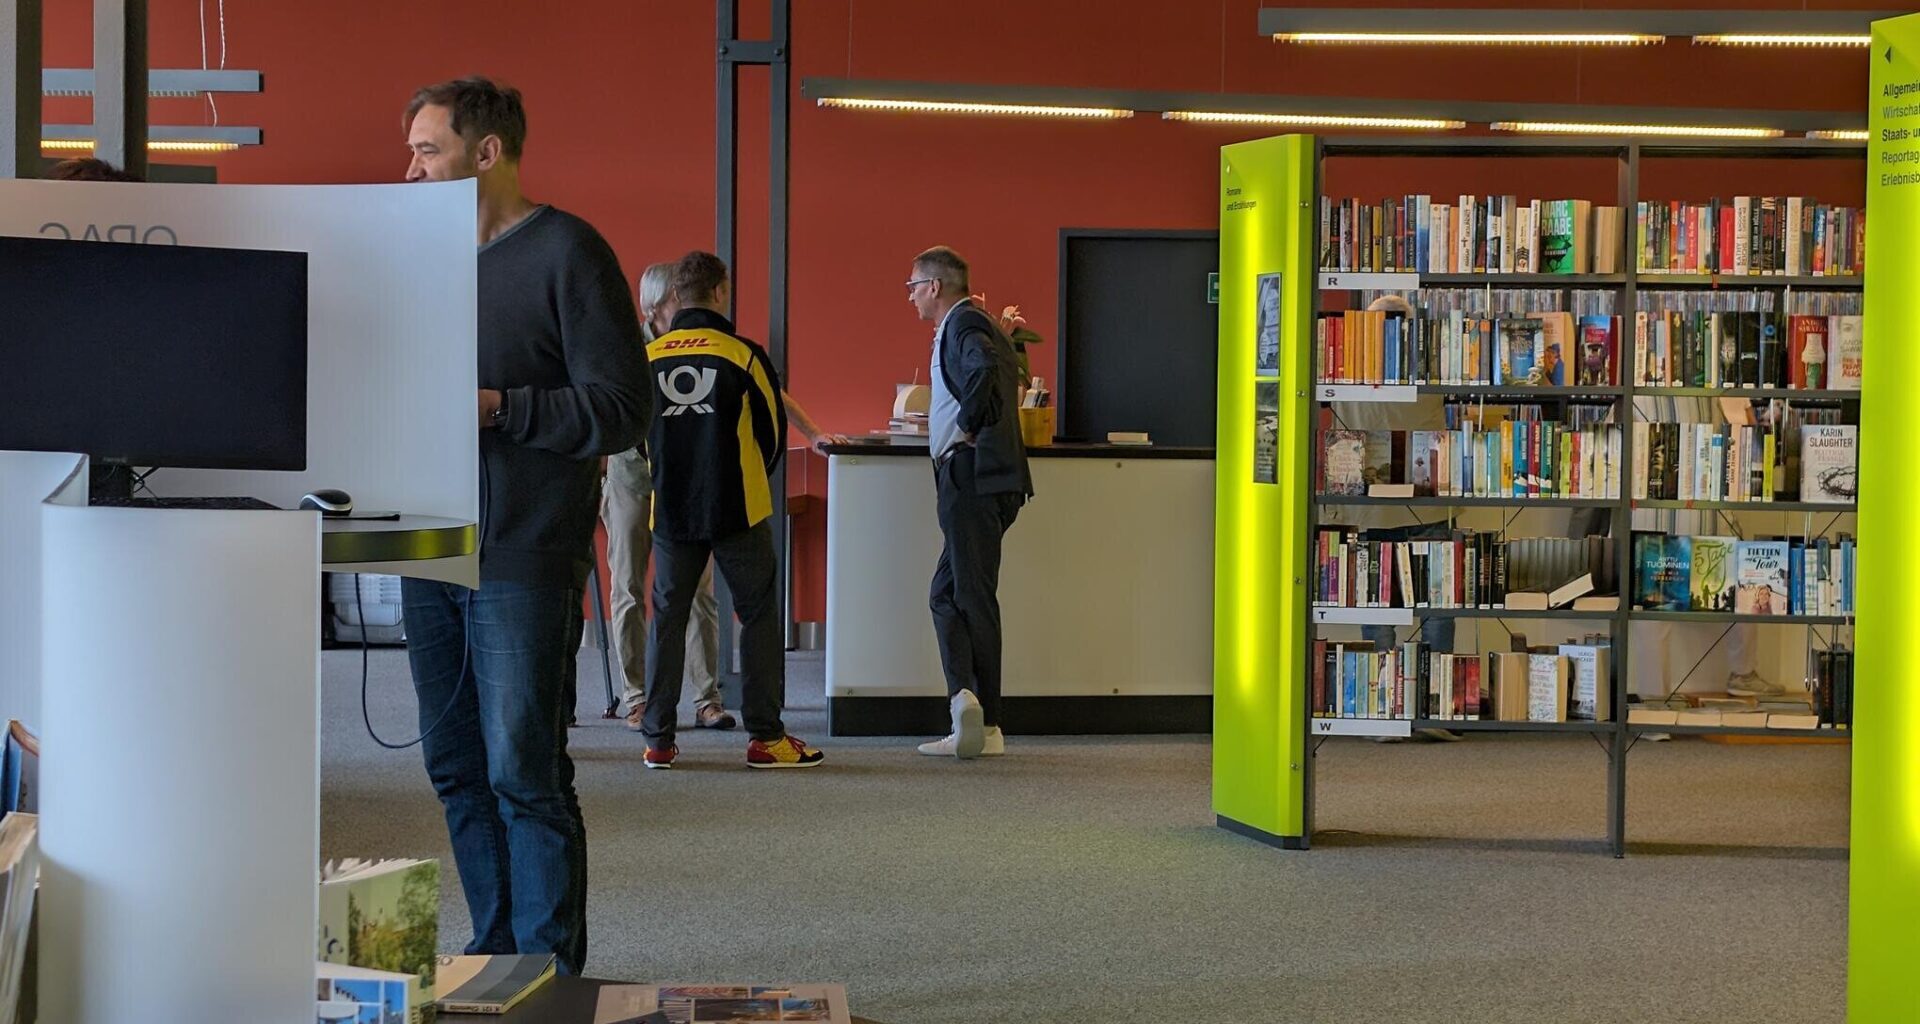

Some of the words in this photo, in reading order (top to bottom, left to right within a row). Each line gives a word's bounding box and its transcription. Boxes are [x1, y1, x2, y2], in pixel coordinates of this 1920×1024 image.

[1882, 127, 1911, 141] Staats-
[1541, 201, 1569, 218] MARC
[1541, 216, 1572, 236] RAABE
[1328, 277, 1338, 286] R
[663, 338, 710, 350] DHL
[1325, 388, 1336, 398] S
[1820, 428, 1843, 438] KARIN
[1809, 437, 1853, 448] SLAUGHTER
[1645, 560, 1690, 569] TUOMINEN
[1752, 555, 1779, 570] Tour
[1318, 611, 1328, 620] T
[1320, 722, 1332, 731] W
